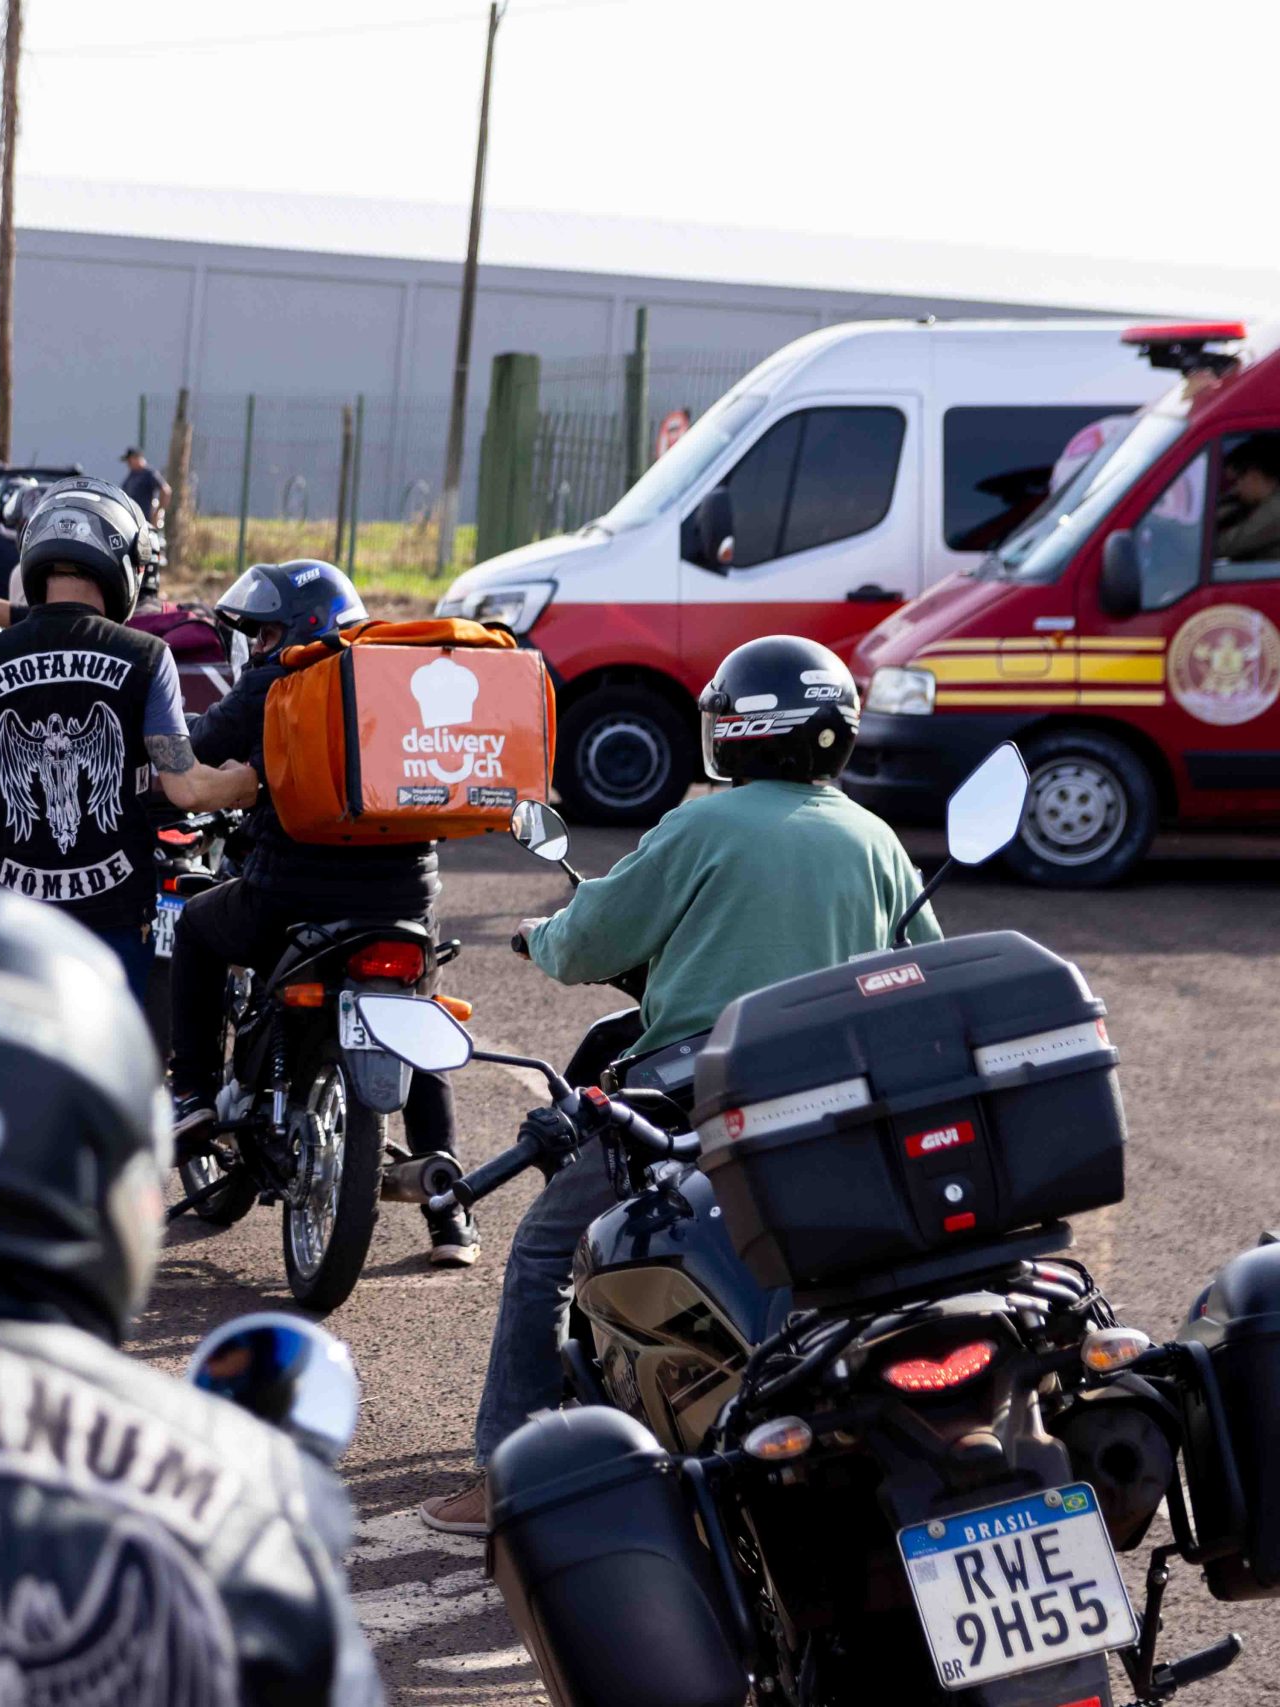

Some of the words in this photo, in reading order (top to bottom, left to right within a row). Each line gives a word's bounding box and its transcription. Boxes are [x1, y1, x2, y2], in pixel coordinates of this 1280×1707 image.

[402, 727, 506, 758] delivery
[403, 753, 503, 784] much
[3, 856, 128, 899] NÔMADE
[864, 966, 919, 991] GIVI
[984, 1037, 1089, 1066] MONOLOCK
[921, 1128, 959, 1150] GIVI
[964, 1511, 1038, 1542] BRASIL
[954, 1528, 1074, 1604] RWE
[955, 1580, 1109, 1667] 9H55
[941, 1657, 966, 1682] BR
